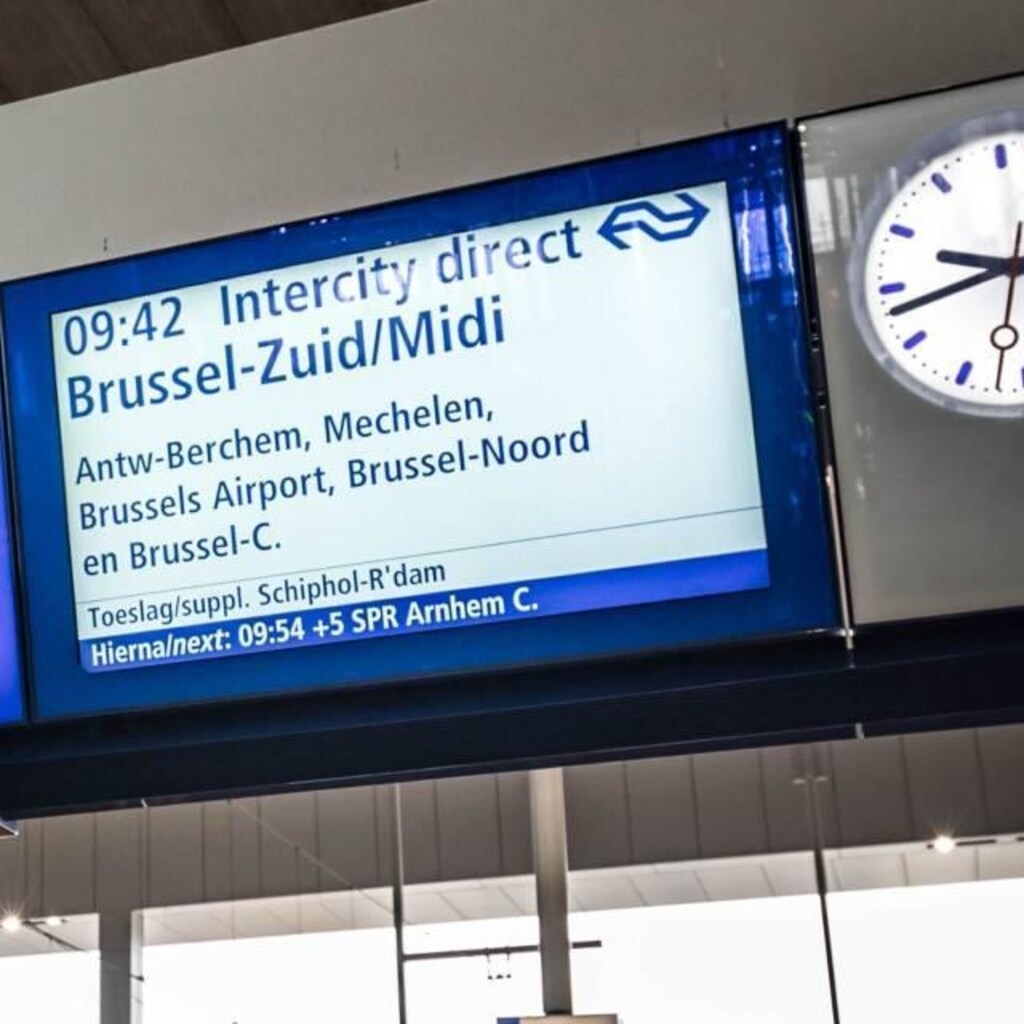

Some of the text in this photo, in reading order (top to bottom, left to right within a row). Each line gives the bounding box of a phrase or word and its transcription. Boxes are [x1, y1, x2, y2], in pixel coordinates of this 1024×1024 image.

[64, 219, 583, 357] 09:42 Intercity direct
[67, 294, 505, 420] Brussel-Zuid/Midi
[75, 393, 494, 486] Antw-Berchem, Mechelen,
[79, 419, 591, 532] Brussels Airport, Brussel-Noord
[83, 521, 282, 577] en Brussel-C.
[87, 562, 447, 629] Toeslag/suppl. Schiphol-R'dam
[90, 586, 539, 668] Hierna/next: 09:54 +5 SPR Arnhem C.
